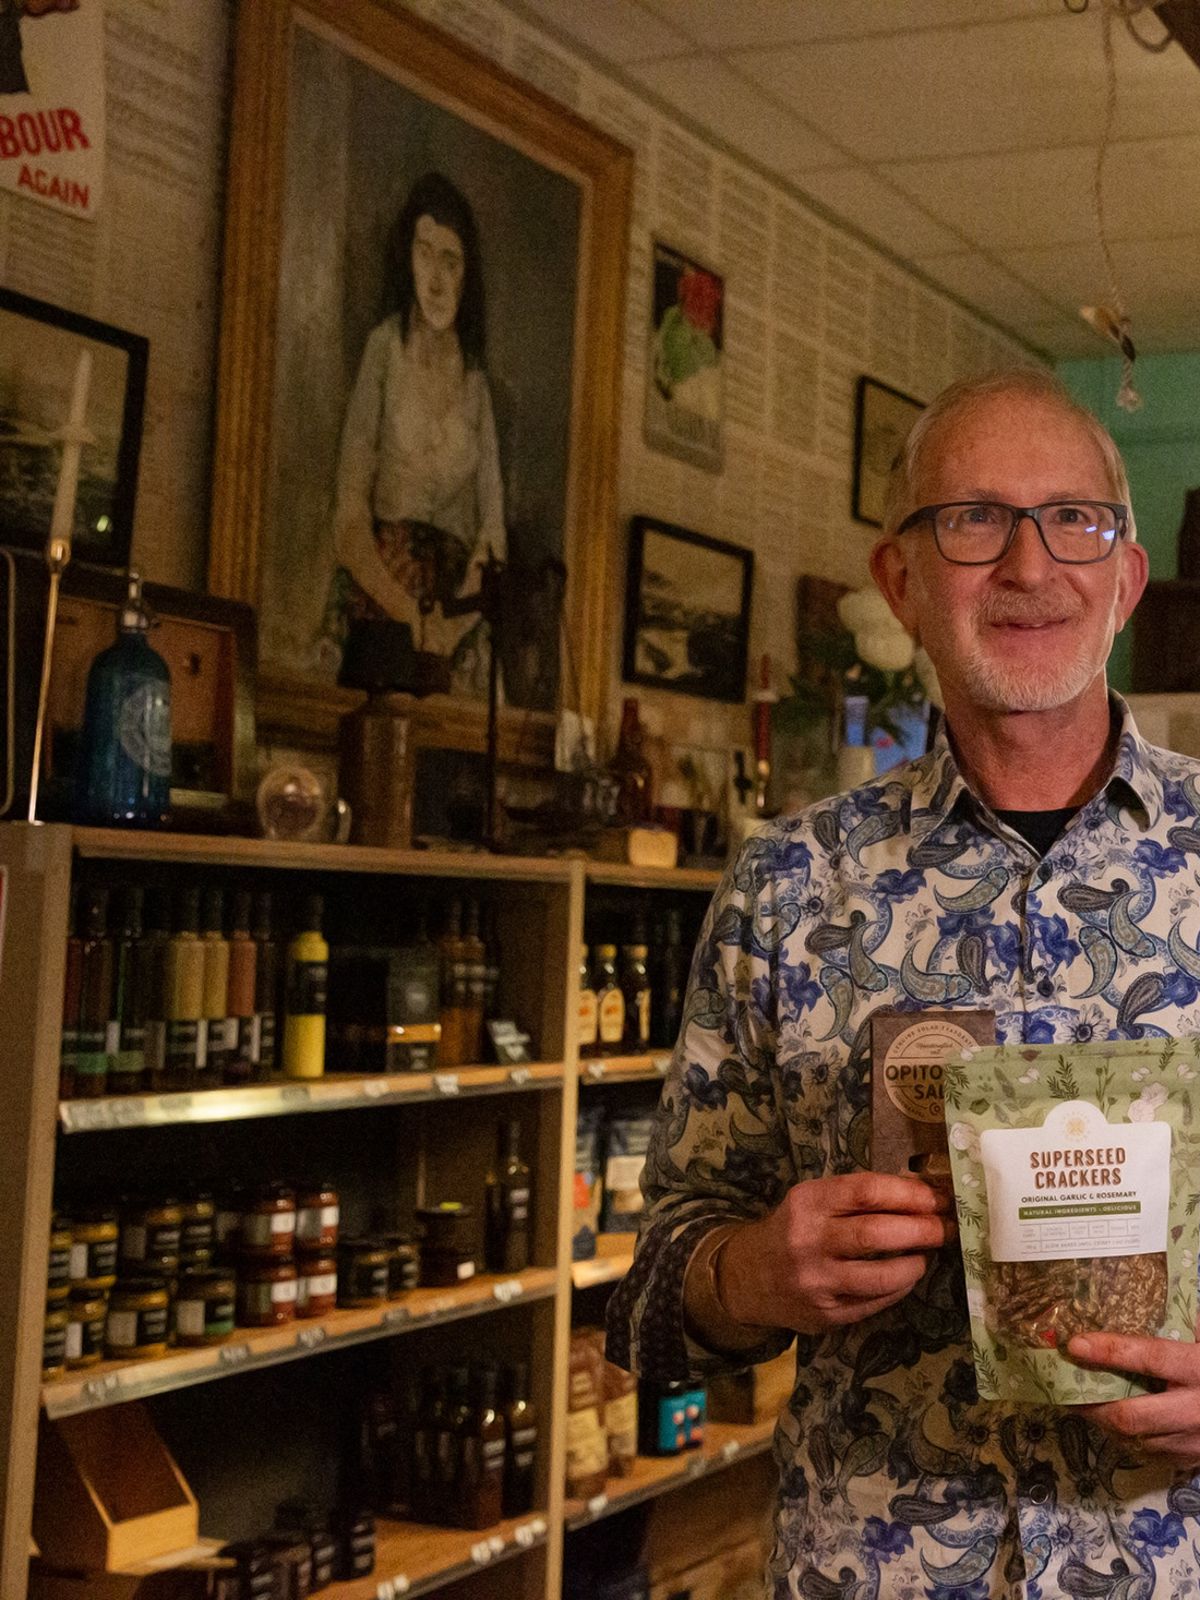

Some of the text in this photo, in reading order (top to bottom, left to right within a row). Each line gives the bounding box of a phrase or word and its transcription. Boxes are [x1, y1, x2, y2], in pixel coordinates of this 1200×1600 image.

[17, 163, 90, 208] AGAIN
[885, 1064, 944, 1081] OPITO
[914, 1084, 945, 1100] SAL
[1030, 1147, 1126, 1169] SUPERSEED
[1034, 1167, 1122, 1189] CRACKERS
[1021, 1195, 1058, 1203] ORIGINAL
[1059, 1193, 1087, 1201] GARLIC
[1096, 1191, 1137, 1200] ROSEMARY
[1023, 1204, 1137, 1216] NATURAL INGREDIENTS DELICIOUS
